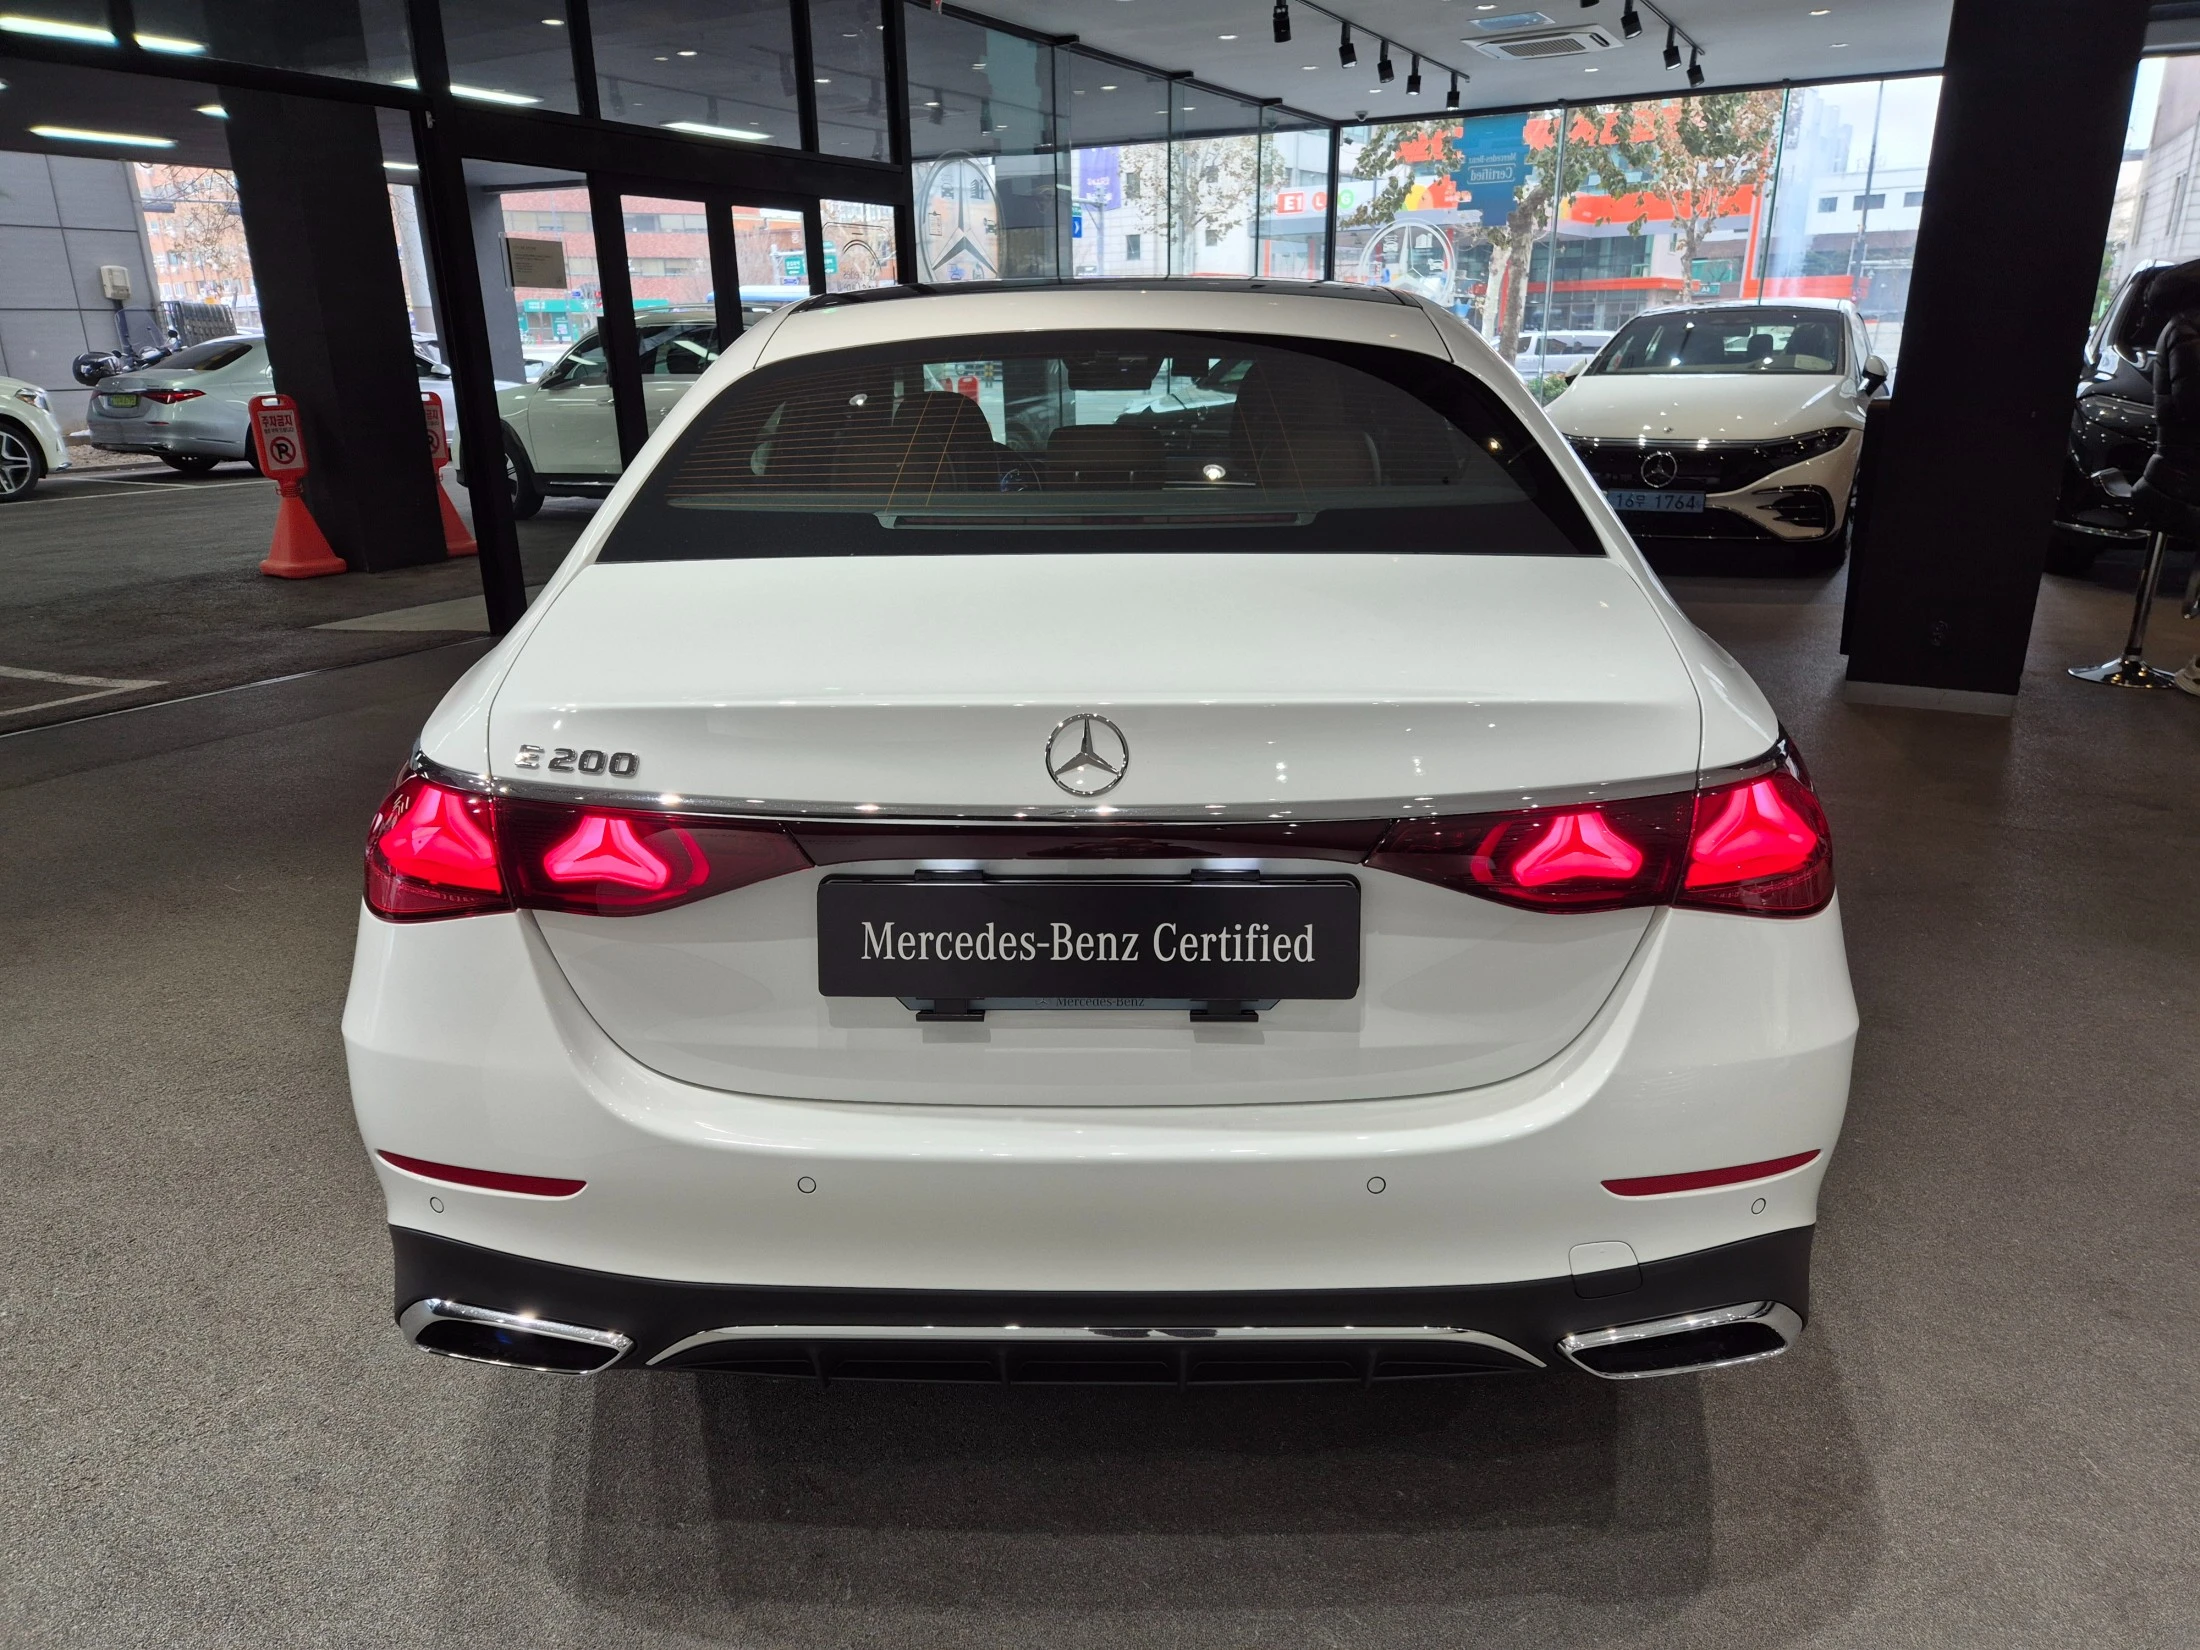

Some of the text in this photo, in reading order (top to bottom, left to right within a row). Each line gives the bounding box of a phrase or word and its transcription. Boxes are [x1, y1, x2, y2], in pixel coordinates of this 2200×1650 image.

[1283, 195, 1303, 211] E1
[1655, 495, 1696, 511] 1764
[514, 744, 640, 777] E 200
[861, 921, 1315, 963] Mercedes-Benz Certified
[1056, 997, 1145, 1008] Mercedes-Benz
